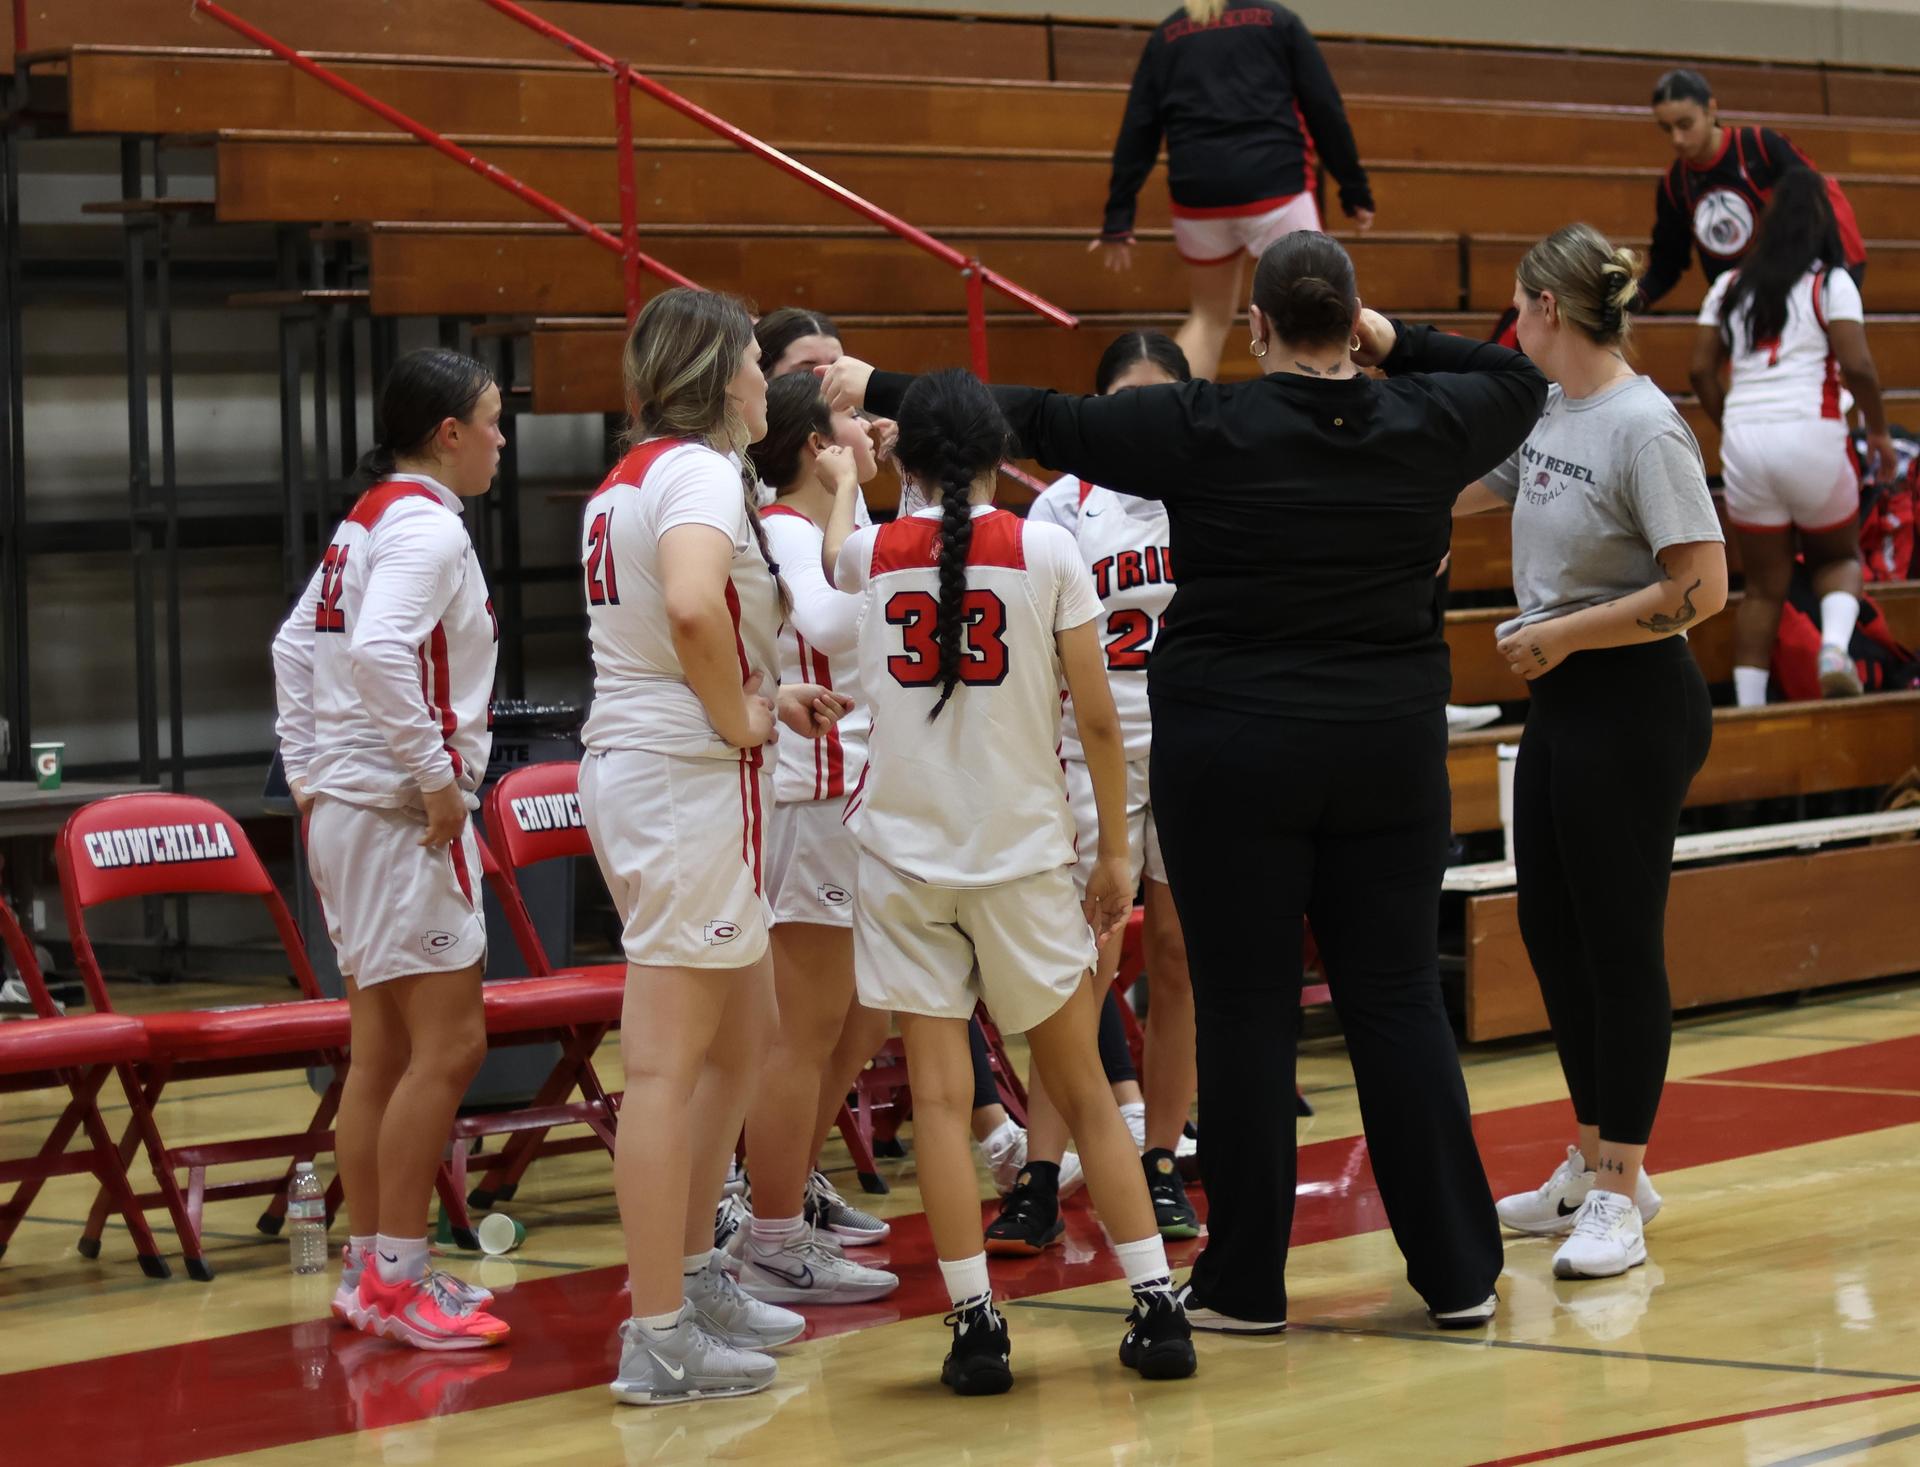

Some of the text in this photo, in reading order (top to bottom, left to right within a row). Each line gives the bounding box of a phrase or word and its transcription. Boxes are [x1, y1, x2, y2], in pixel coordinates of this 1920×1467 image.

[1545, 456, 1596, 486] REBEL
[587, 505, 621, 606] 21
[315, 543, 351, 633] 32
[884, 588, 1010, 688] 33
[1104, 608, 1168, 670] 2
[37, 752, 57, 776] G
[84, 822, 237, 869] CHOWCHILLA
[825, 890, 845, 902] C
[430, 935, 449, 948] C
[714, 926, 735, 938] C
